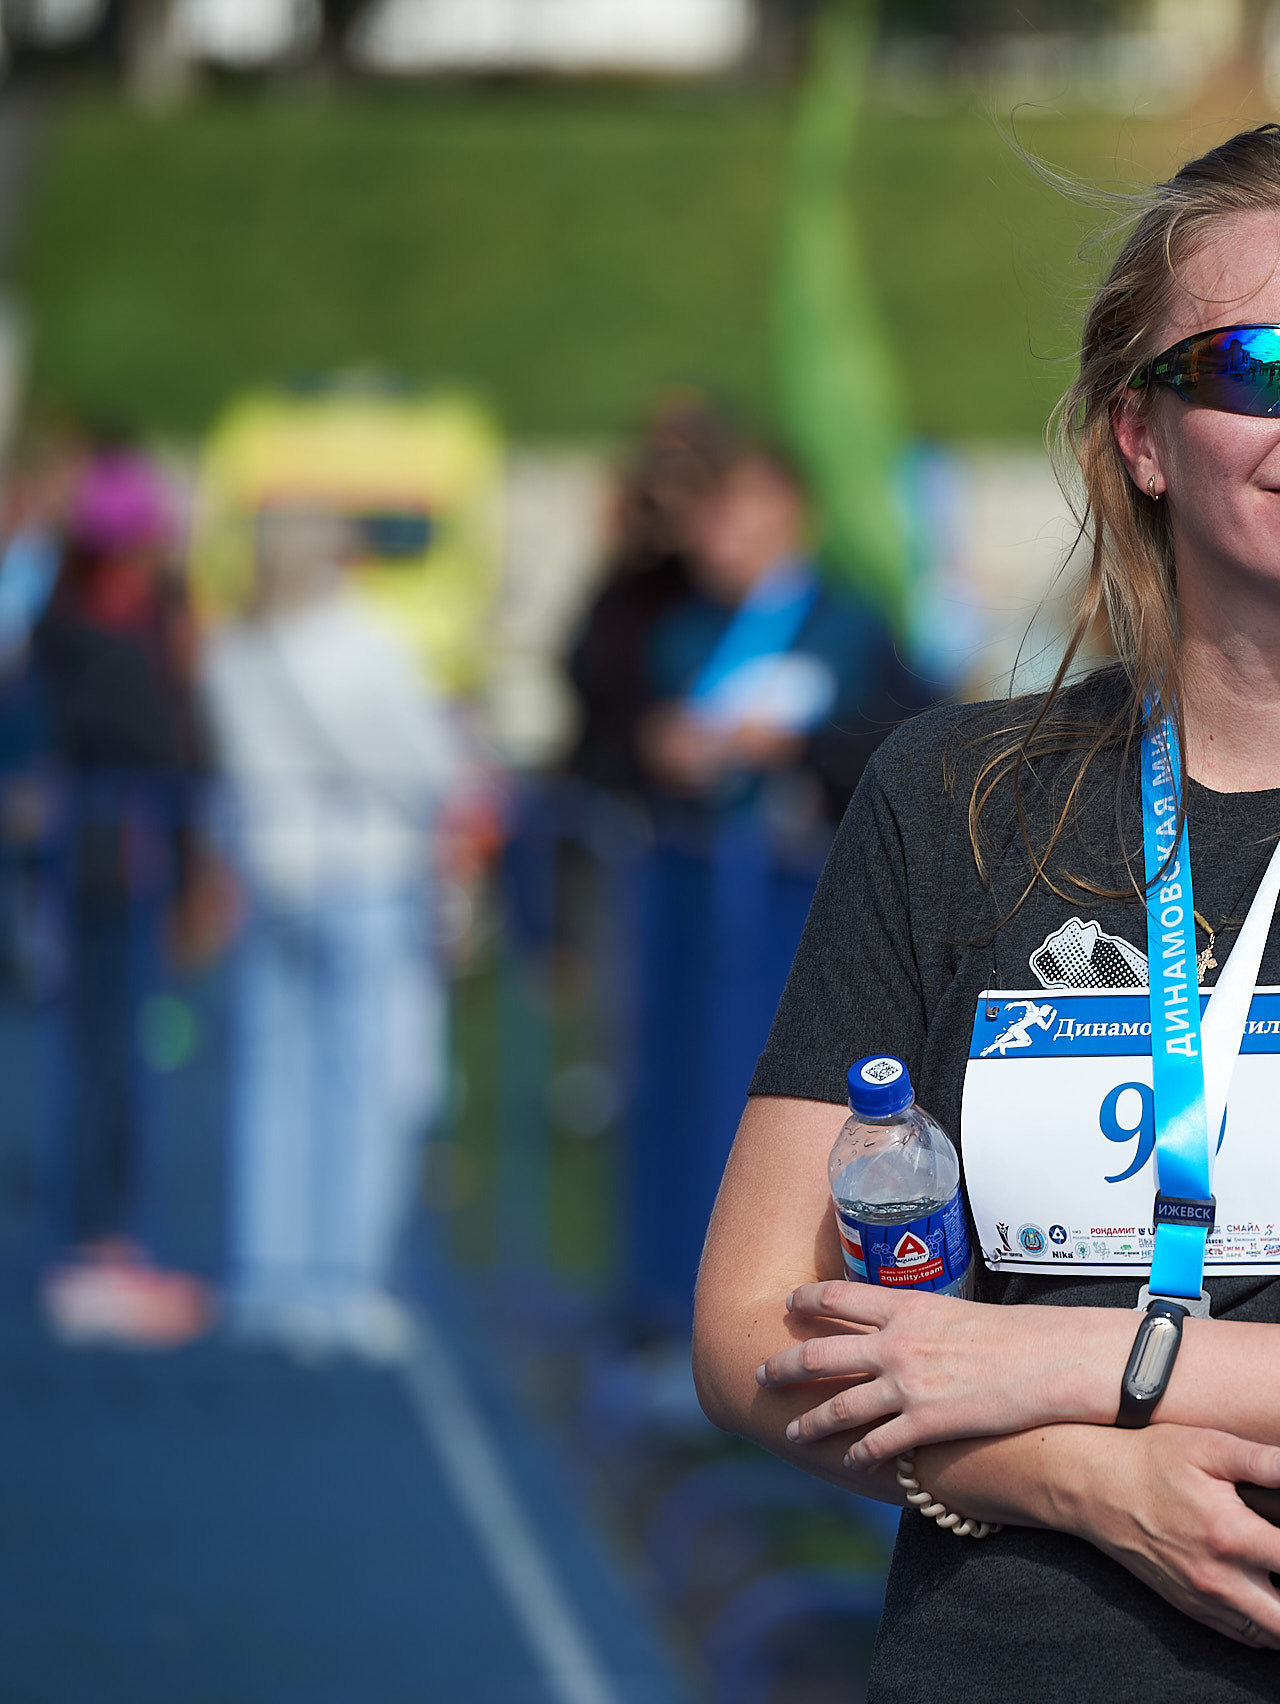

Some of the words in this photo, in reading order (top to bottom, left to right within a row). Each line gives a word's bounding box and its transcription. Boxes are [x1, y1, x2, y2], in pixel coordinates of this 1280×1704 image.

[1154, 796, 1198, 1057] ДИНАМОВСКАЯ
[1053, 1018, 1152, 1041] Динамо
[1158, 1204, 1211, 1219] ИЖЕВСК
[1090, 1227, 1136, 1236] РОНДАМИТ
[1226, 1222, 1260, 1232] СМАЙЛ
[897, 1254, 927, 1264] AQUALITY
[881, 1266, 943, 1283] aquality.team
